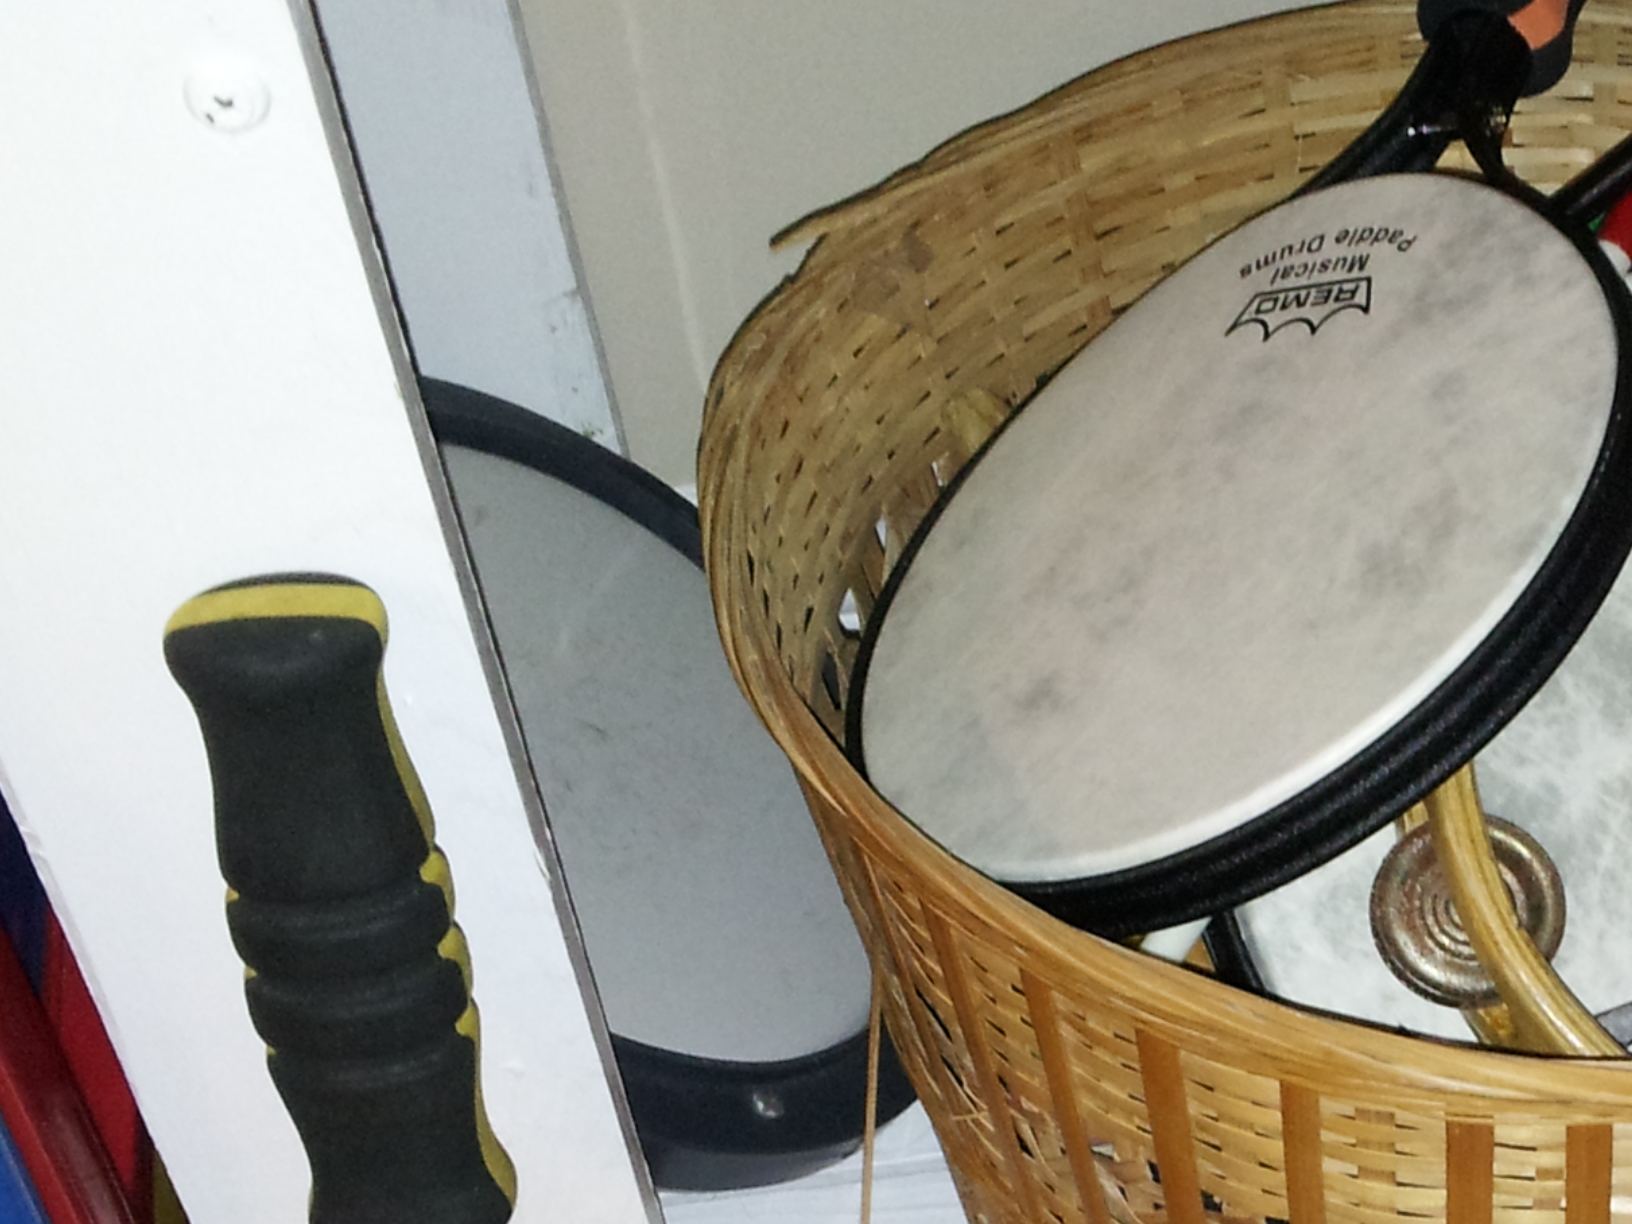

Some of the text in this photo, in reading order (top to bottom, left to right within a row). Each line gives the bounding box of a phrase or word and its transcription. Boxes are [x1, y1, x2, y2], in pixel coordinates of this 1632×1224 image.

[1239, 227, 1418, 279] Paddle Drums
[1270, 253, 1370, 286] Musical
[1255, 283, 1360, 315] REMO
